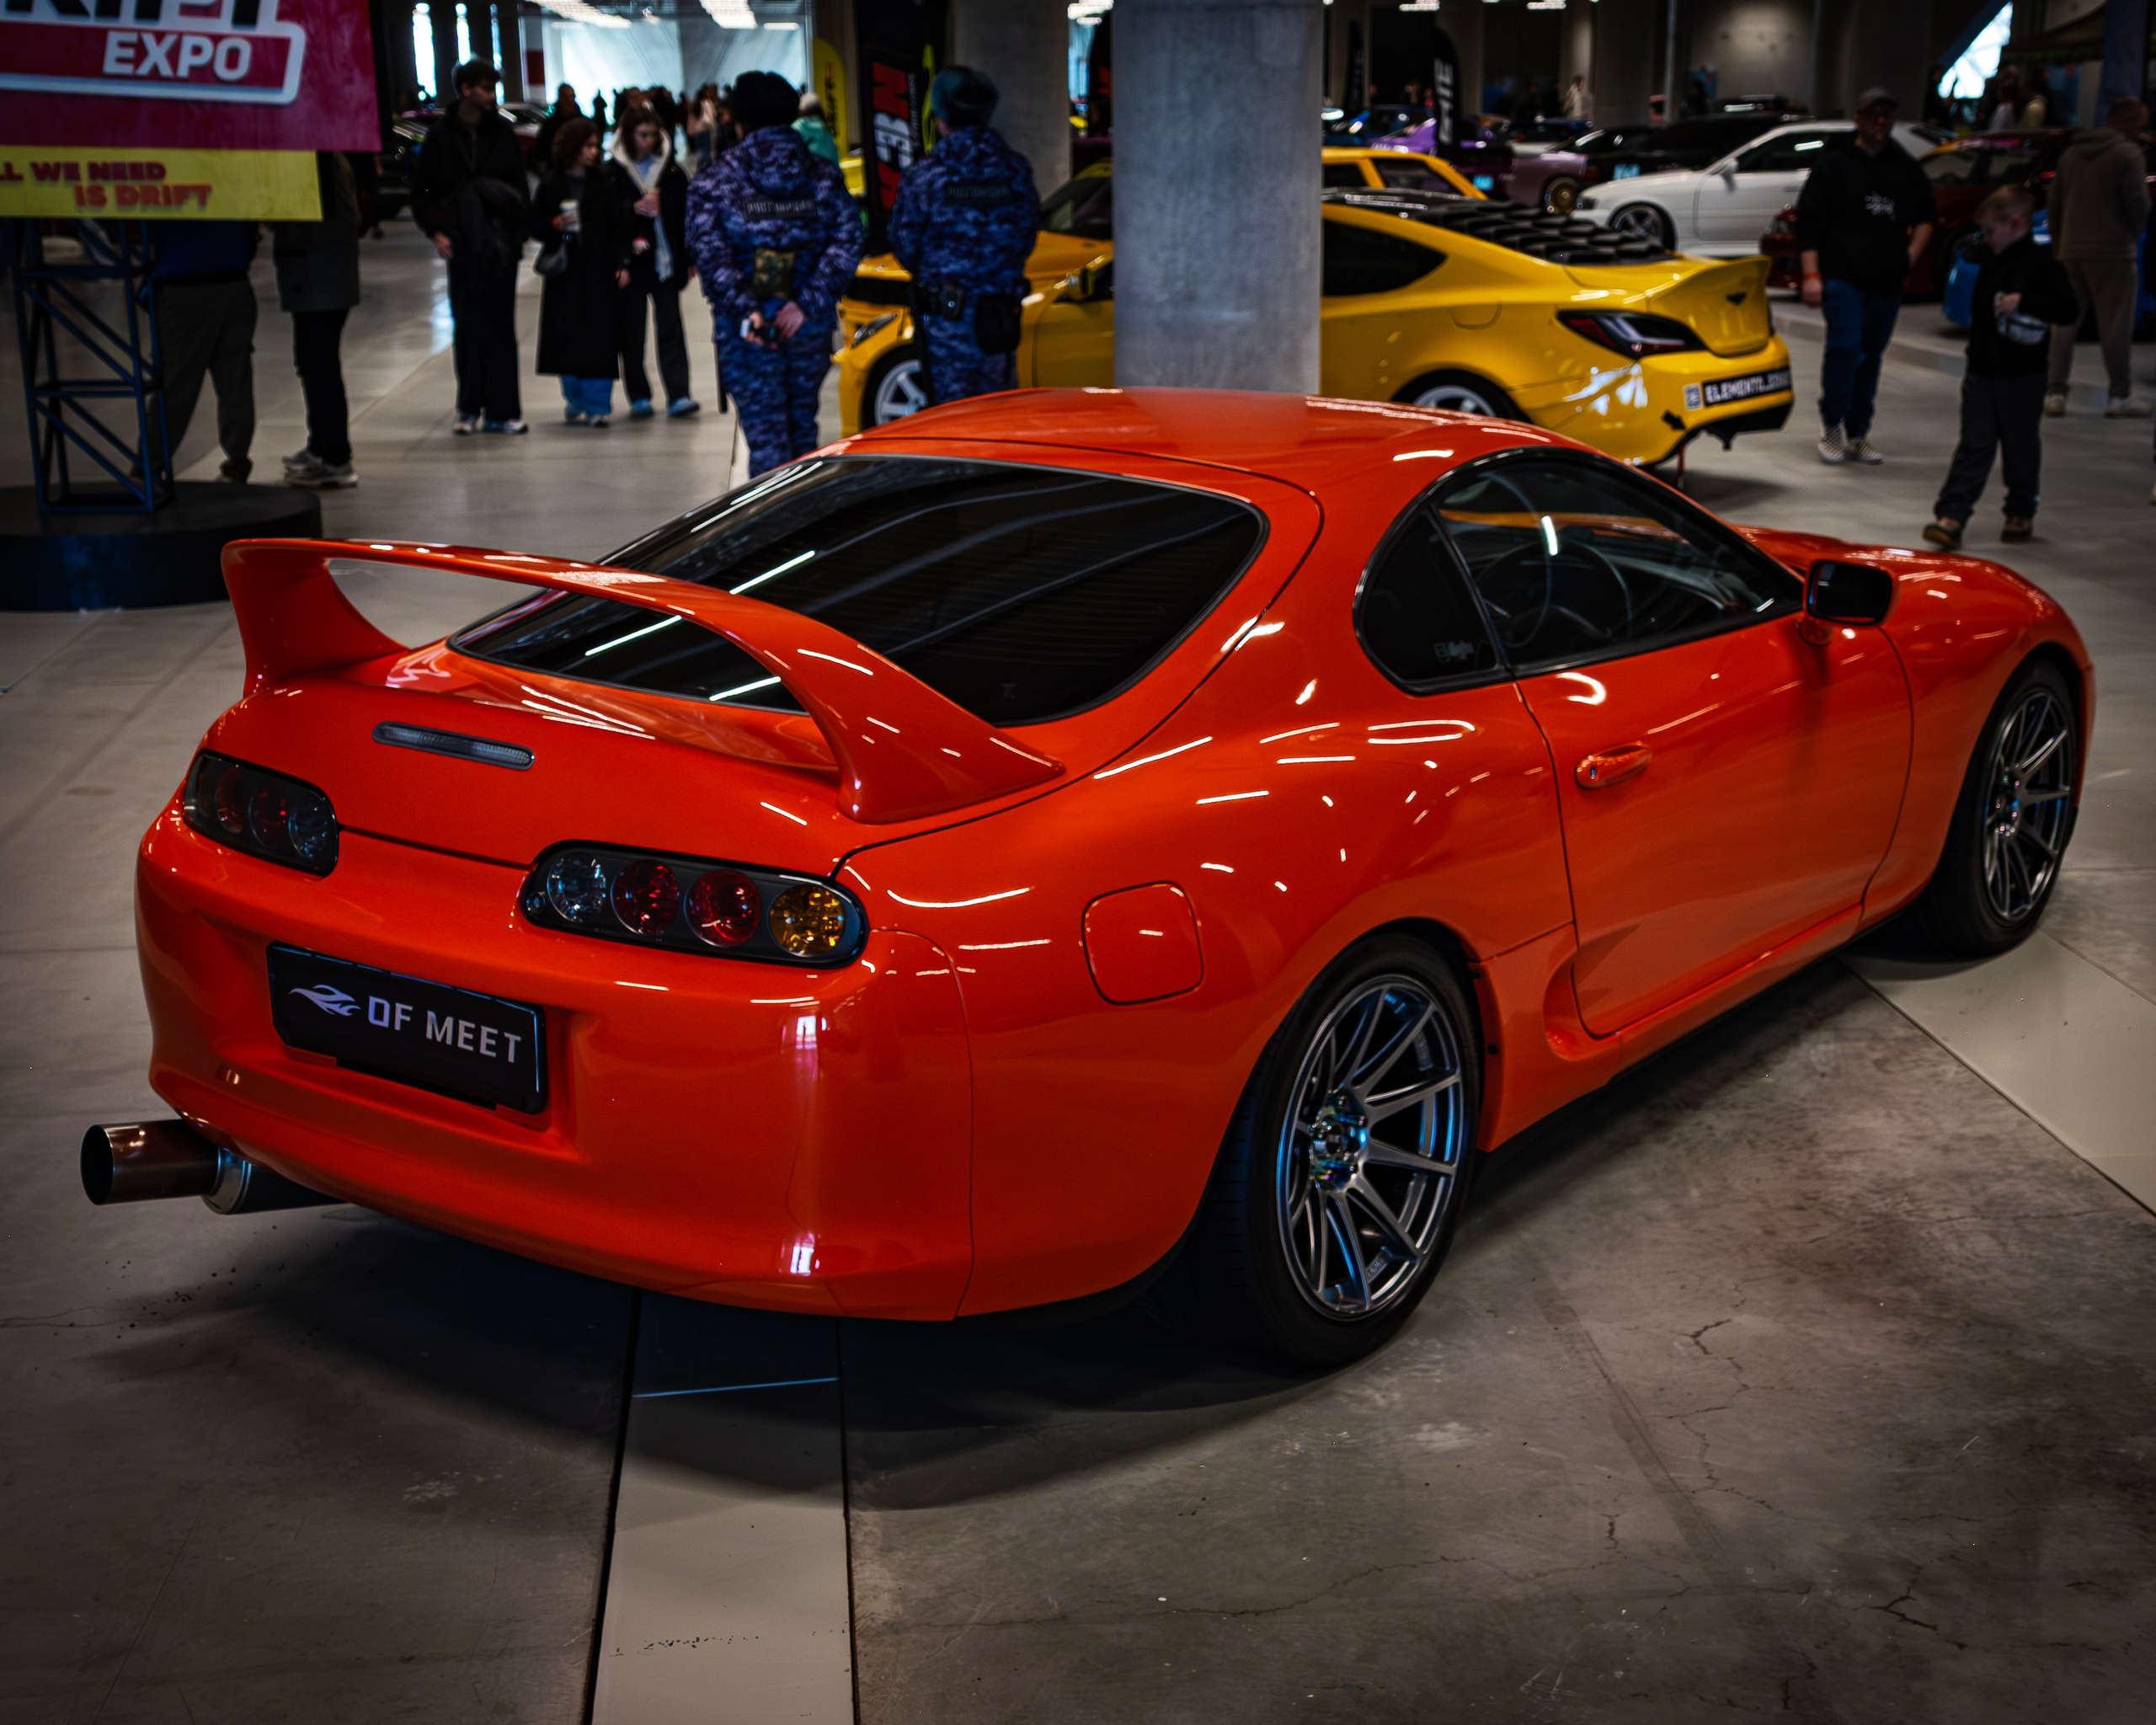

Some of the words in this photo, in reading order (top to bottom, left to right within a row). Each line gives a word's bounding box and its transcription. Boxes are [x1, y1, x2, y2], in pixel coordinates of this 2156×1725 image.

[103, 30, 252, 81] EXPO
[29, 161, 81, 181] WE
[87, 161, 166, 181] NEED
[74, 184, 107, 207] IS
[115, 184, 211, 207] DRIFT
[368, 995, 414, 1032] OF
[425, 1010, 521, 1064] MEET
